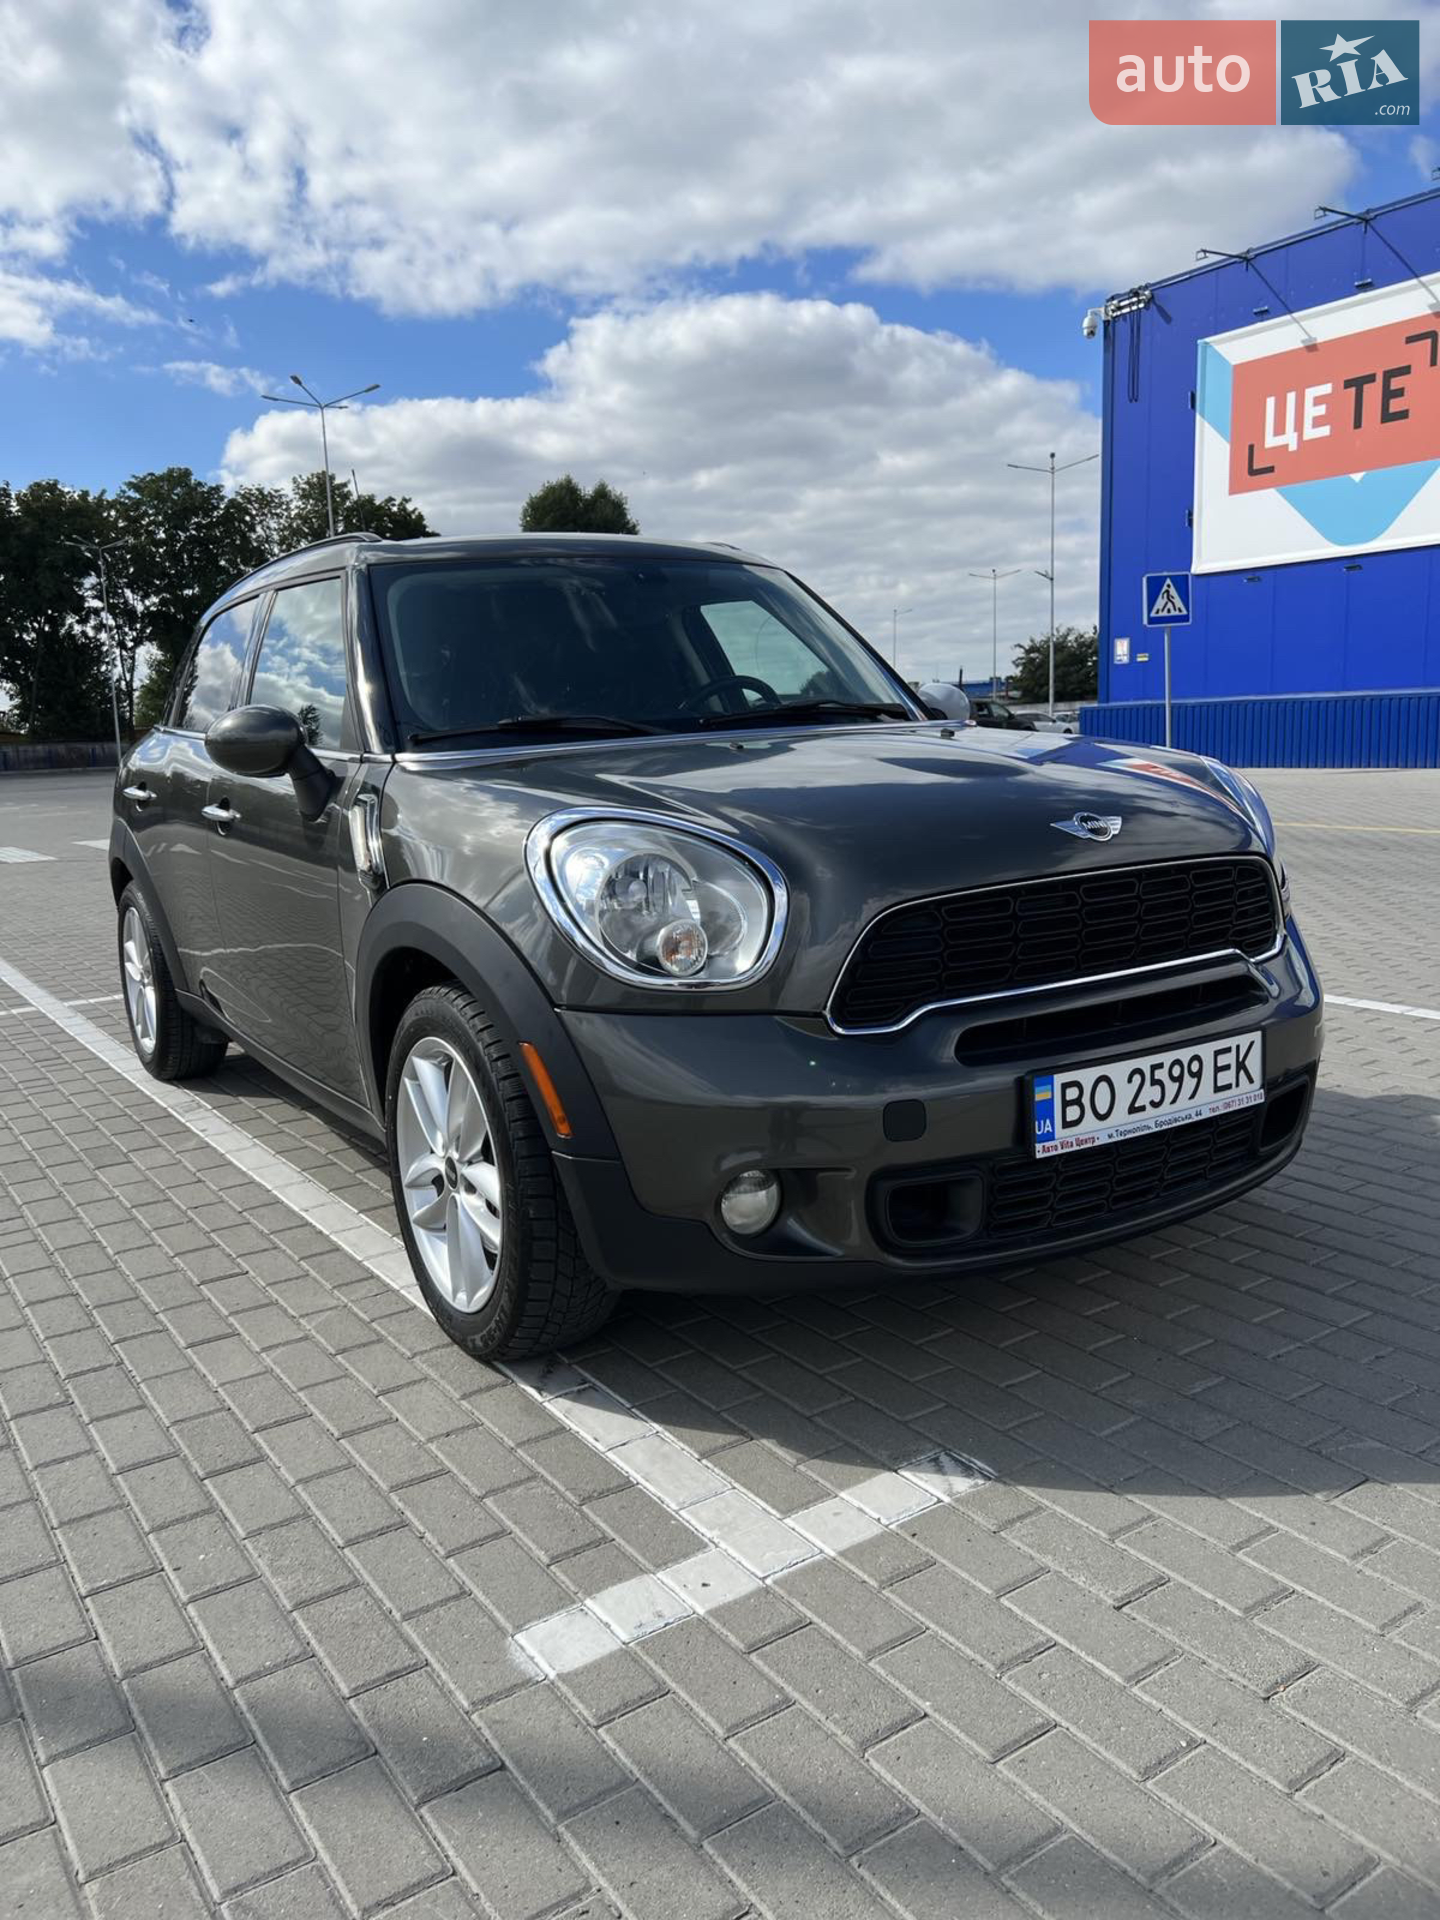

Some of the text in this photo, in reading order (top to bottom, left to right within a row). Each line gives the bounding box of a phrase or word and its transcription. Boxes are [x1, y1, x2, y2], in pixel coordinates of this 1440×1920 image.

[1264, 364, 1412, 452] ЦЕ ТЕ
[1082, 820, 1108, 830] MINI
[1127, 1053, 1204, 1116] 2599
[1035, 1118, 1053, 1134] UA
